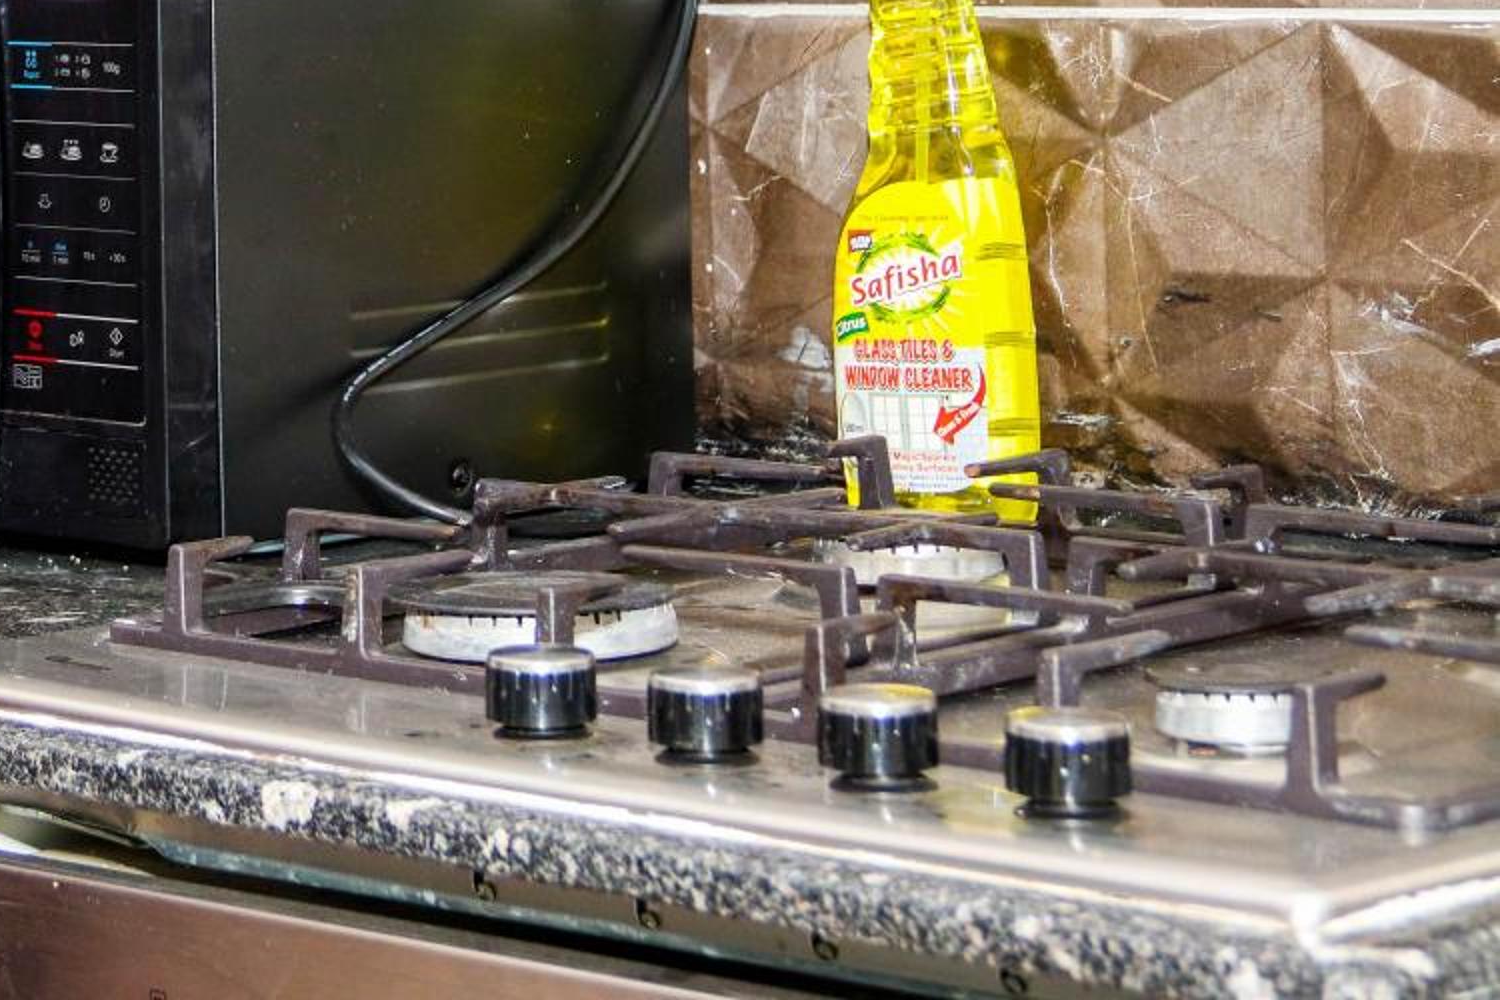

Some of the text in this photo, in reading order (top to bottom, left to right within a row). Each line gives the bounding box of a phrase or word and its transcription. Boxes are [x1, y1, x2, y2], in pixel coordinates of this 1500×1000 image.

[852, 254, 960, 305] Safisha
[900, 339, 938, 362] TILES
[940, 338, 955, 362] &
[845, 364, 975, 392] WINDOW CLEANER
